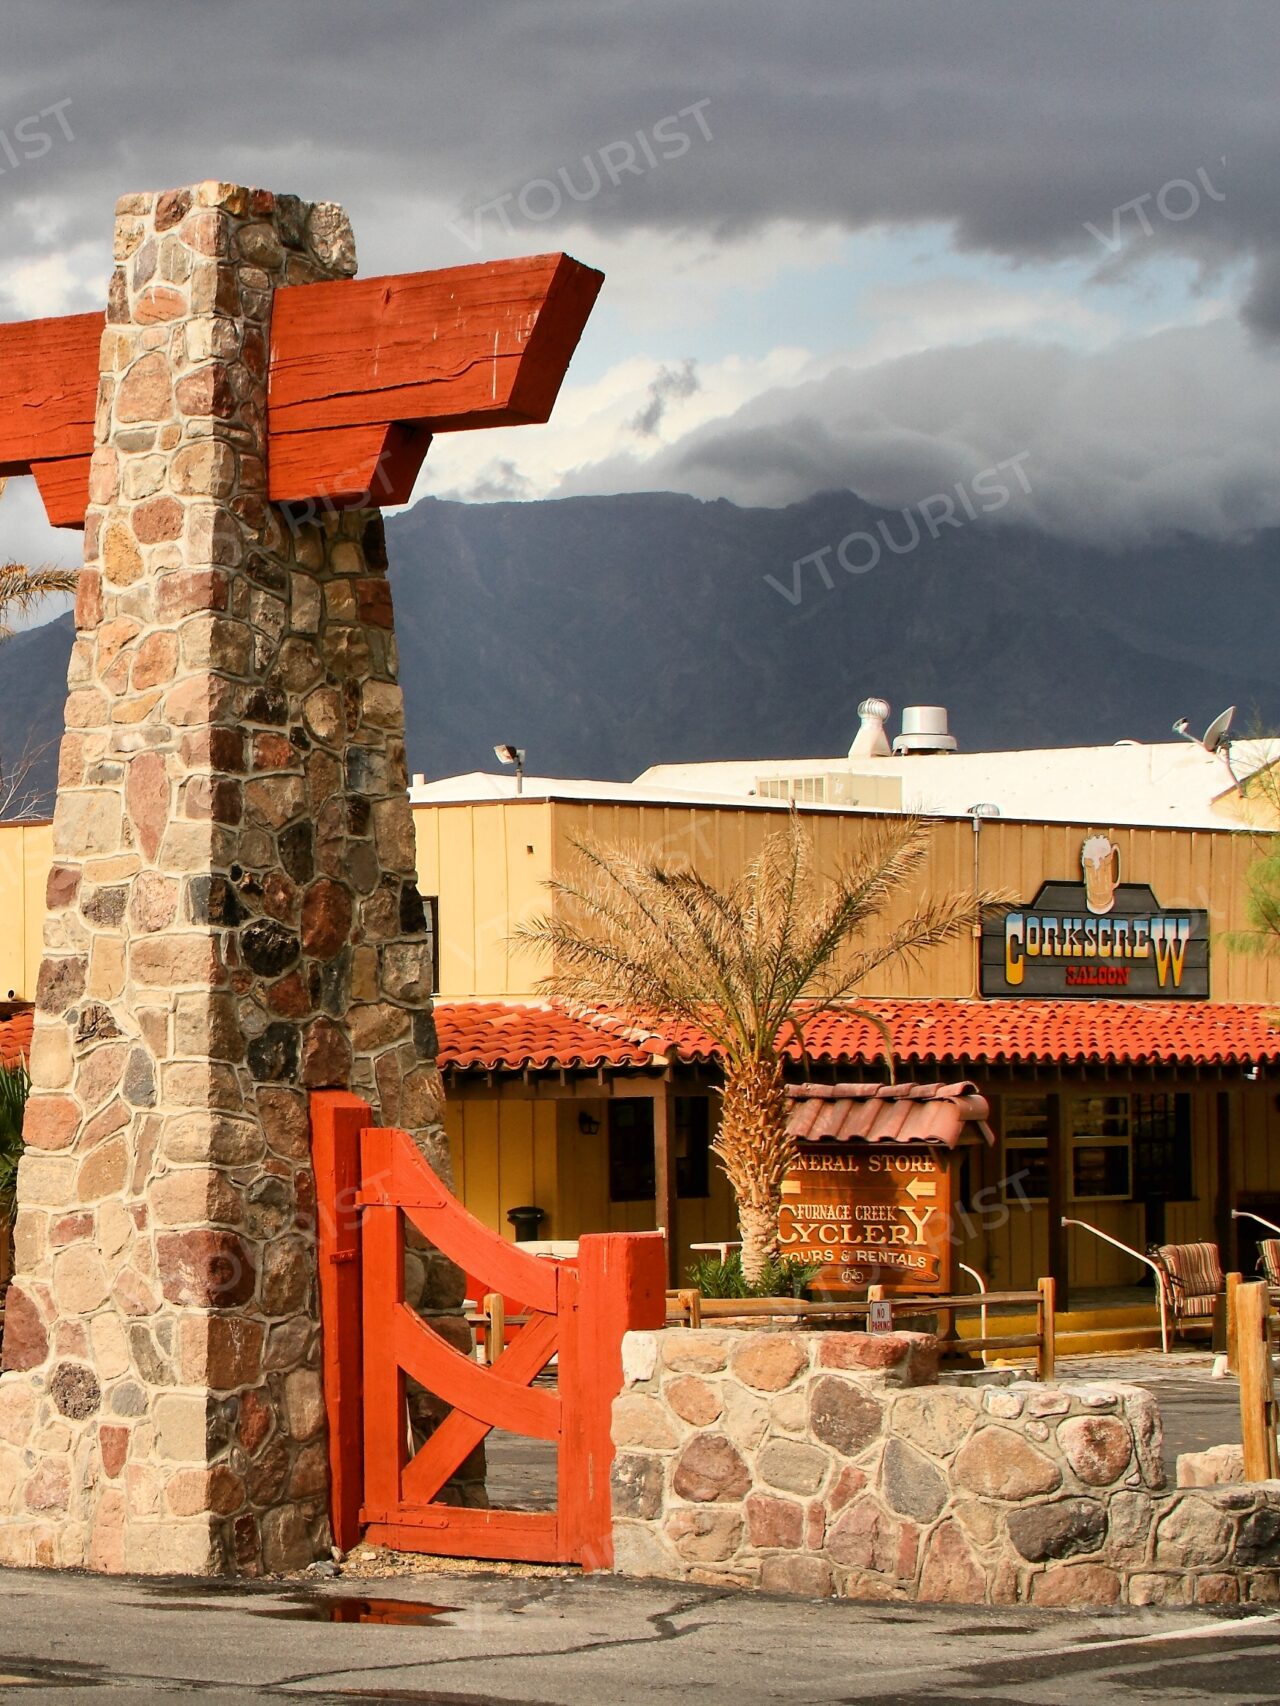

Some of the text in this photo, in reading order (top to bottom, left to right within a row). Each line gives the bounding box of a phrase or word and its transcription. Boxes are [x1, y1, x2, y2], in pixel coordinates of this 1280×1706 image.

[1005, 913, 1190, 987] CORKSCREW
[1066, 966, 1130, 985] SALOON
[788, 1154, 936, 1172] NERAL STORE
[797, 1204, 898, 1221] FURNACE CREEK
[777, 1204, 937, 1245] CYCLERY
[781, 1250, 927, 1268] TOURS & RENTALS
[872, 1307, 891, 1332] NO PARKING
